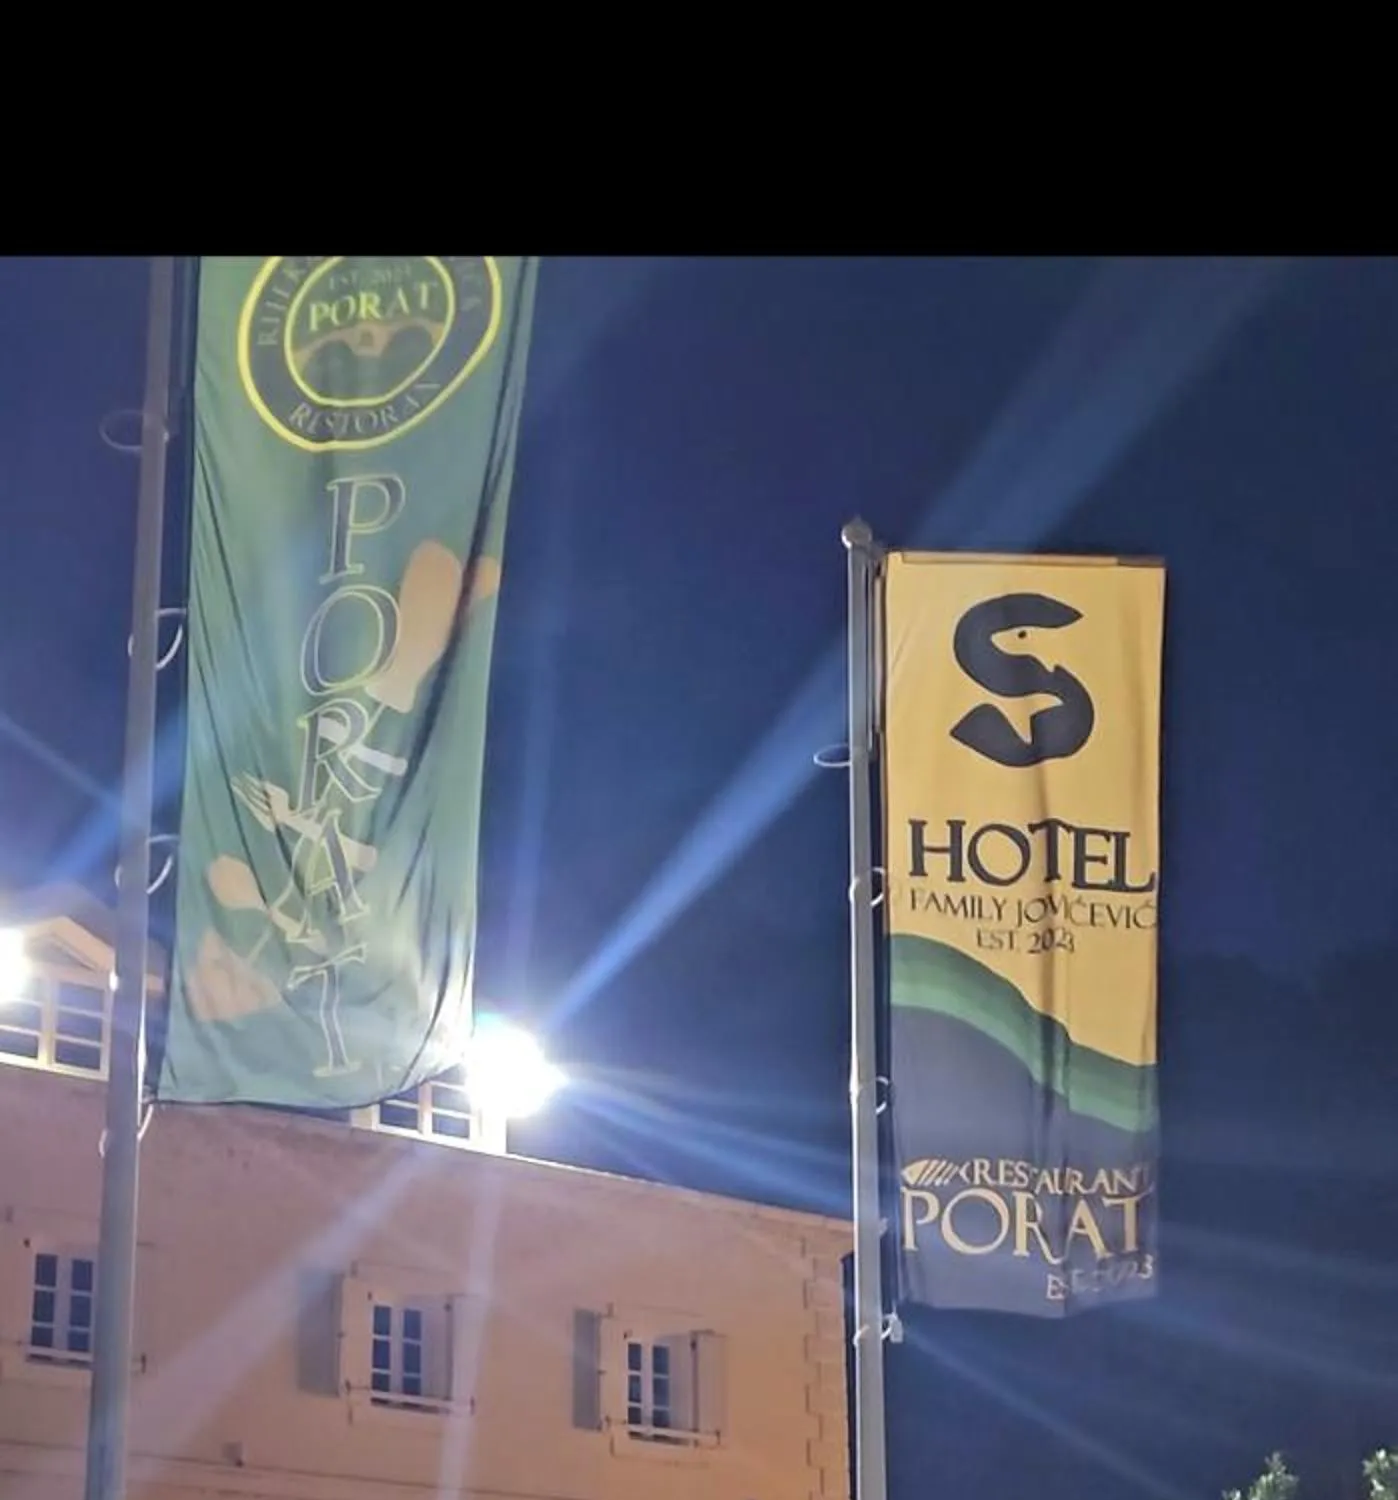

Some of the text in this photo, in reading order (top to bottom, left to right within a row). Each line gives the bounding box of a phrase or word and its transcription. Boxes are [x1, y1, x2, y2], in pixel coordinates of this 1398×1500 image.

[309, 280, 439, 332] PORAT
[909, 818, 1157, 893] HOTEL
[910, 889, 1011, 922] FAMILY
[973, 1158, 1150, 1196] RESTAURANT
[901, 1183, 1155, 1265] PORAT
